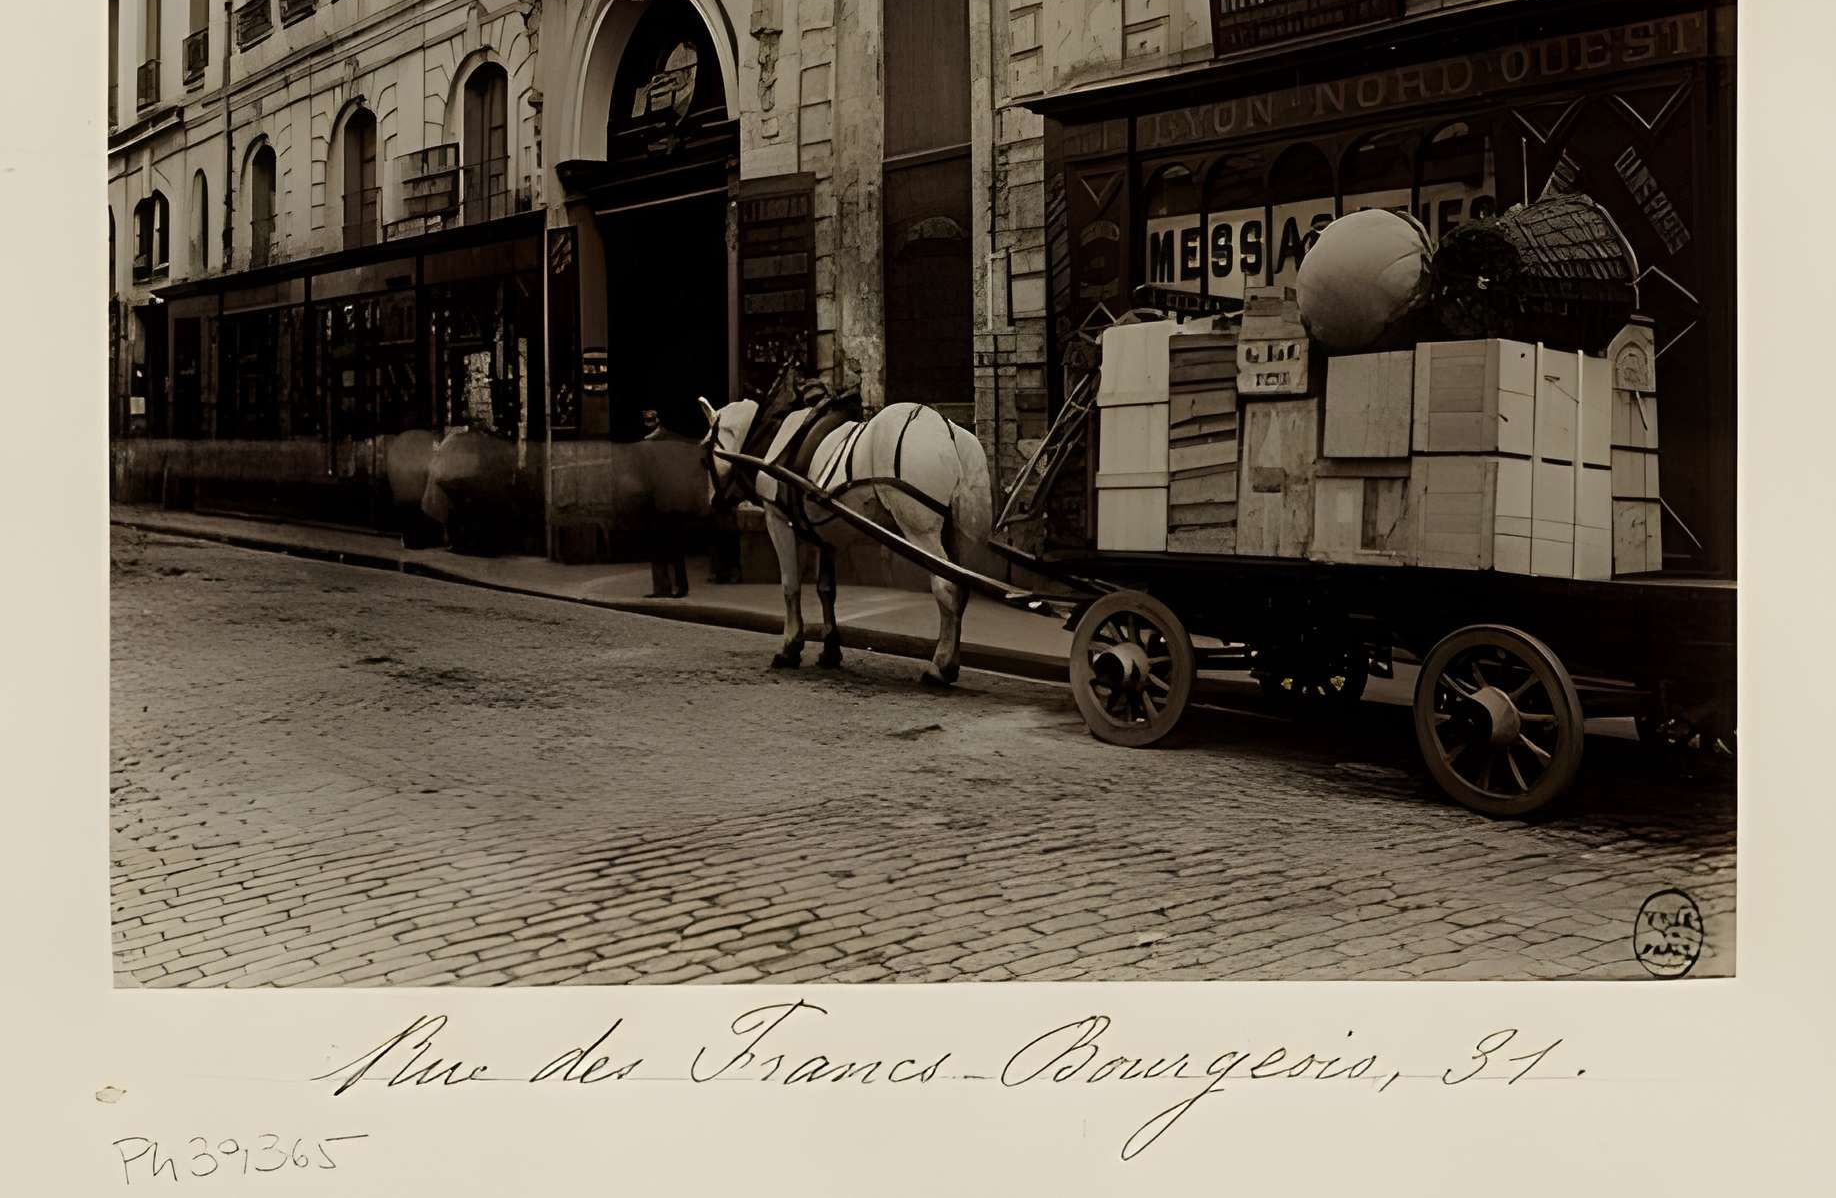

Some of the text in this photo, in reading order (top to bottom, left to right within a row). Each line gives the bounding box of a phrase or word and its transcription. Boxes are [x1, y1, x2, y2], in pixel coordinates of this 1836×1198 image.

[1311, 59, 1474, 116] NORD
[1500, 16, 1704, 83] OUEST
[310, 1014, 490, 1097] Rue
[529, 1018, 646, 1085] des
